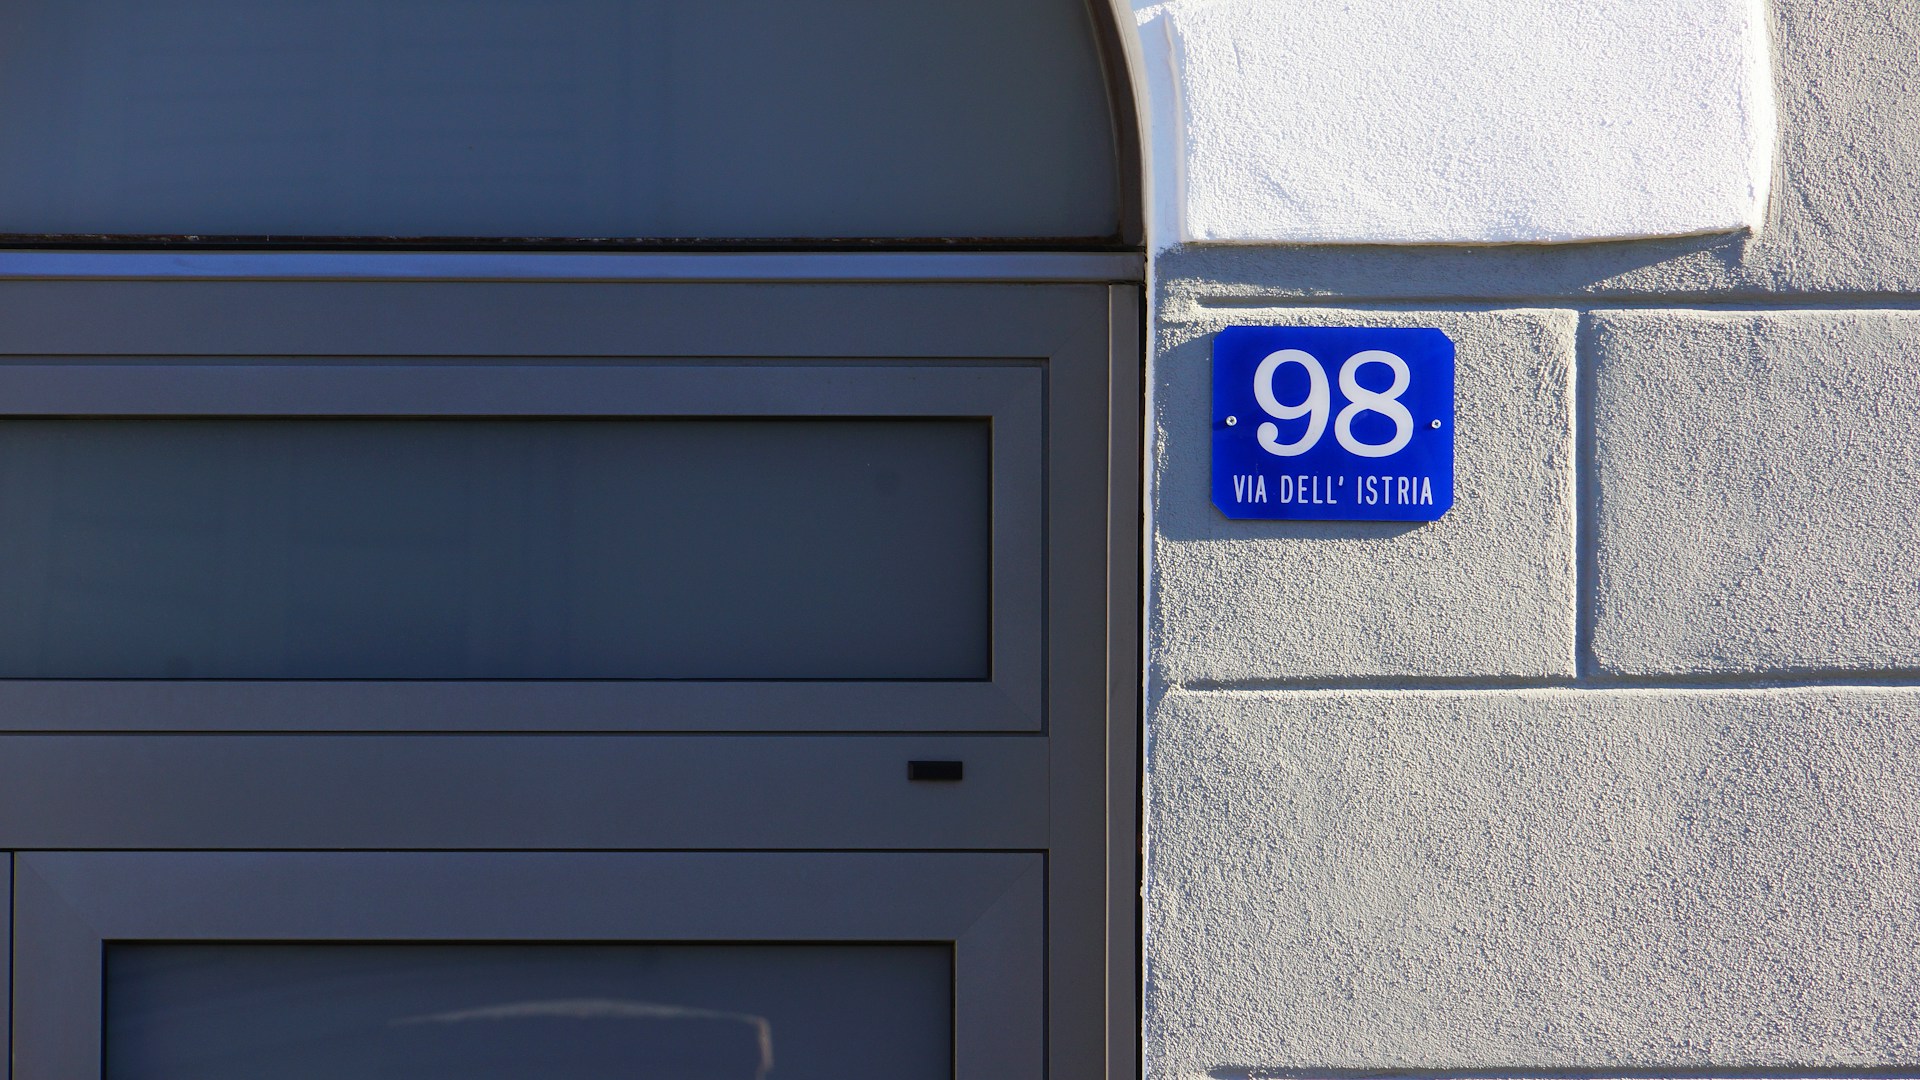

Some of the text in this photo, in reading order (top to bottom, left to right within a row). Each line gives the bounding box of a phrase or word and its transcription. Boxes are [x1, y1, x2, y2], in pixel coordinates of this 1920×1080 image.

[1253, 348, 1414, 458] 98
[1233, 474, 1433, 505] VIA DELL' ISTRIA
